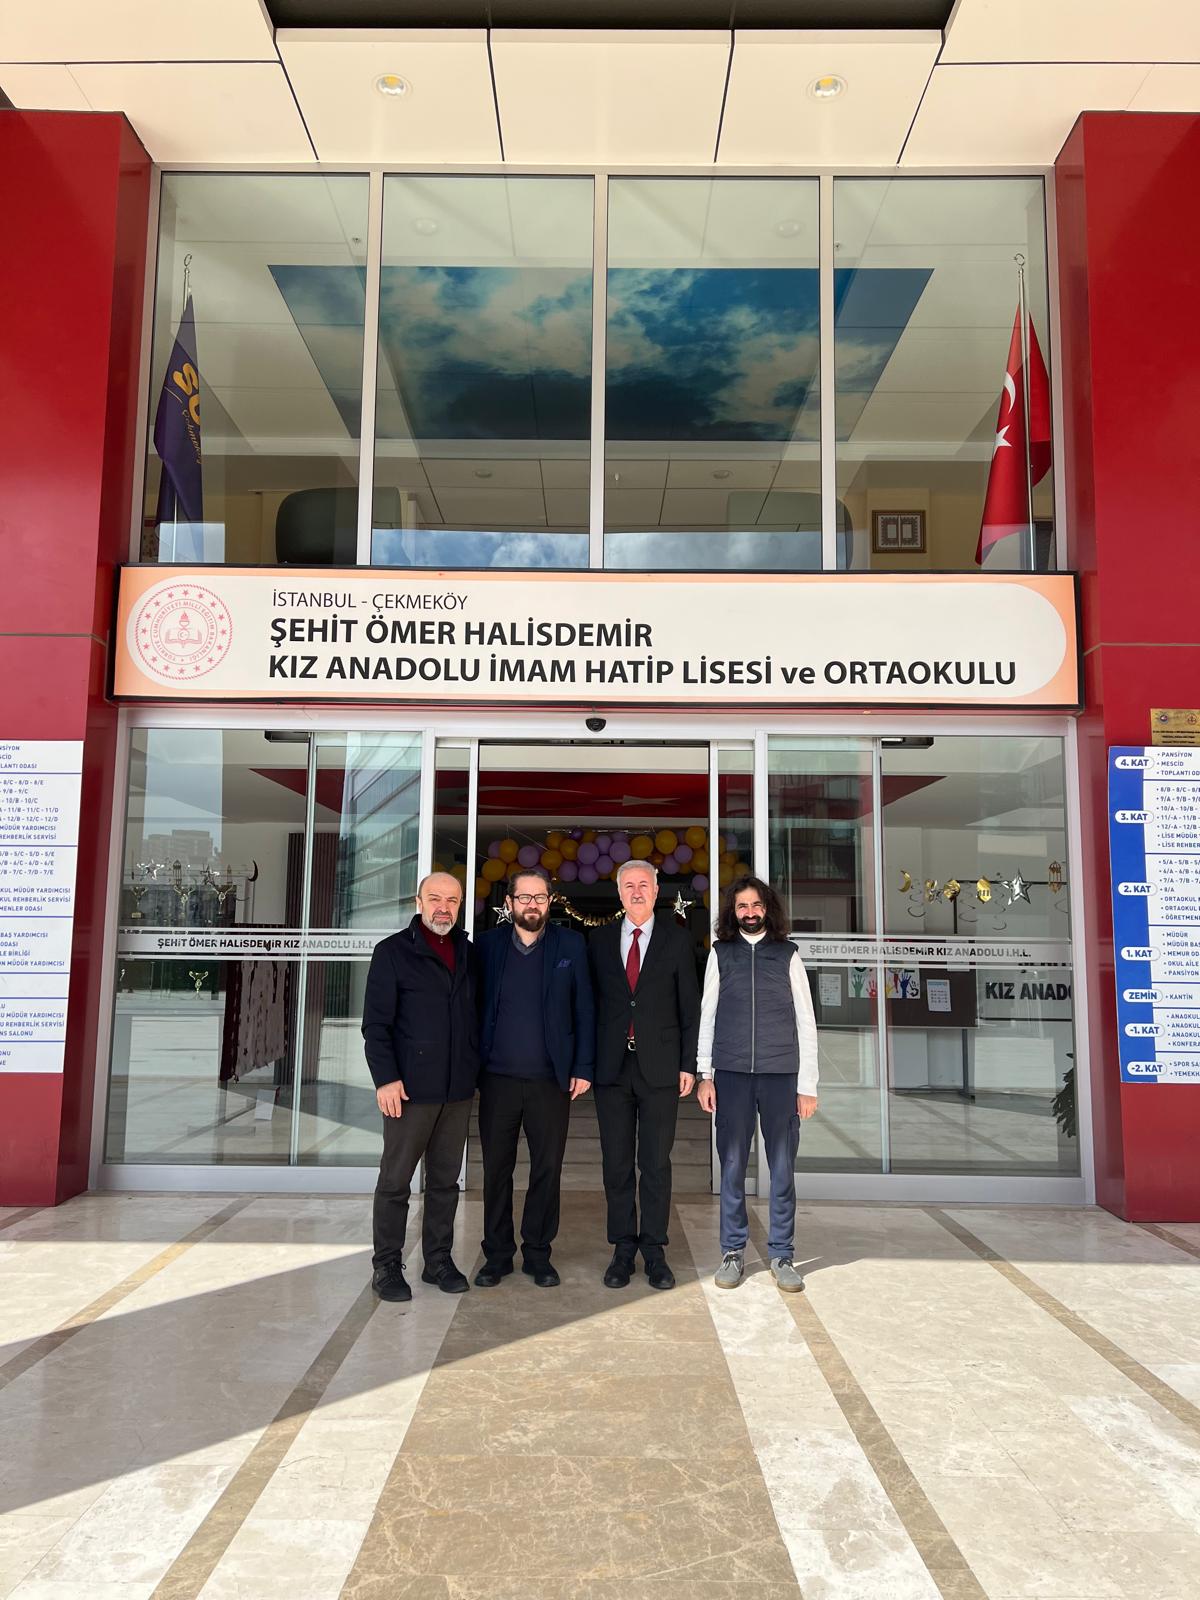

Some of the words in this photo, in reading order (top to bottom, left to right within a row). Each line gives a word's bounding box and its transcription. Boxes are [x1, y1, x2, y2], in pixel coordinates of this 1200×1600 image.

[273, 588, 356, 608] İSTANBUL
[372, 592, 468, 611] ÇEKMEKÖY
[271, 614, 358, 647] ŞEHİT
[366, 614, 455, 644] ÖMER
[465, 617, 653, 647] HALİSDEMİR
[270, 655, 318, 678] KIZ
[326, 657, 480, 681] ANADOLU
[490, 654, 575, 682] İMAM
[586, 655, 673, 683] HATİP
[683, 656, 771, 684] LİSESİ
[781, 667, 815, 684] ve
[824, 661, 1016, 685] ORTAOKULU
[1161, 750, 1193, 758] PANSİYON
[1120, 759, 1130, 767] 4.
[1131, 759, 1149, 767] KAT
[1120, 813, 1129, 821] 3.
[1130, 813, 1148, 821] KAT
[1123, 885, 1132, 893] 2.
[1133, 885, 1151, 893] KAT
[283, 940, 300, 948] KIZ
[302, 940, 350, 949] ANADOLU
[840, 944, 870, 954] ÖMER
[936, 947, 953, 956] KIZ
[954, 948, 1004, 957] ANADOLU
[1126, 949, 1134, 958] 1.
[1134, 949, 1153, 958] KAT
[985, 982, 1015, 1000] KIZ
[1128, 991, 1158, 1000] ZEMİN
[1130, 1026, 1140, 1034] -1.
[1131, 1065, 1143, 1073] -2.
[1145, 1065, 1163, 1073] KAT
